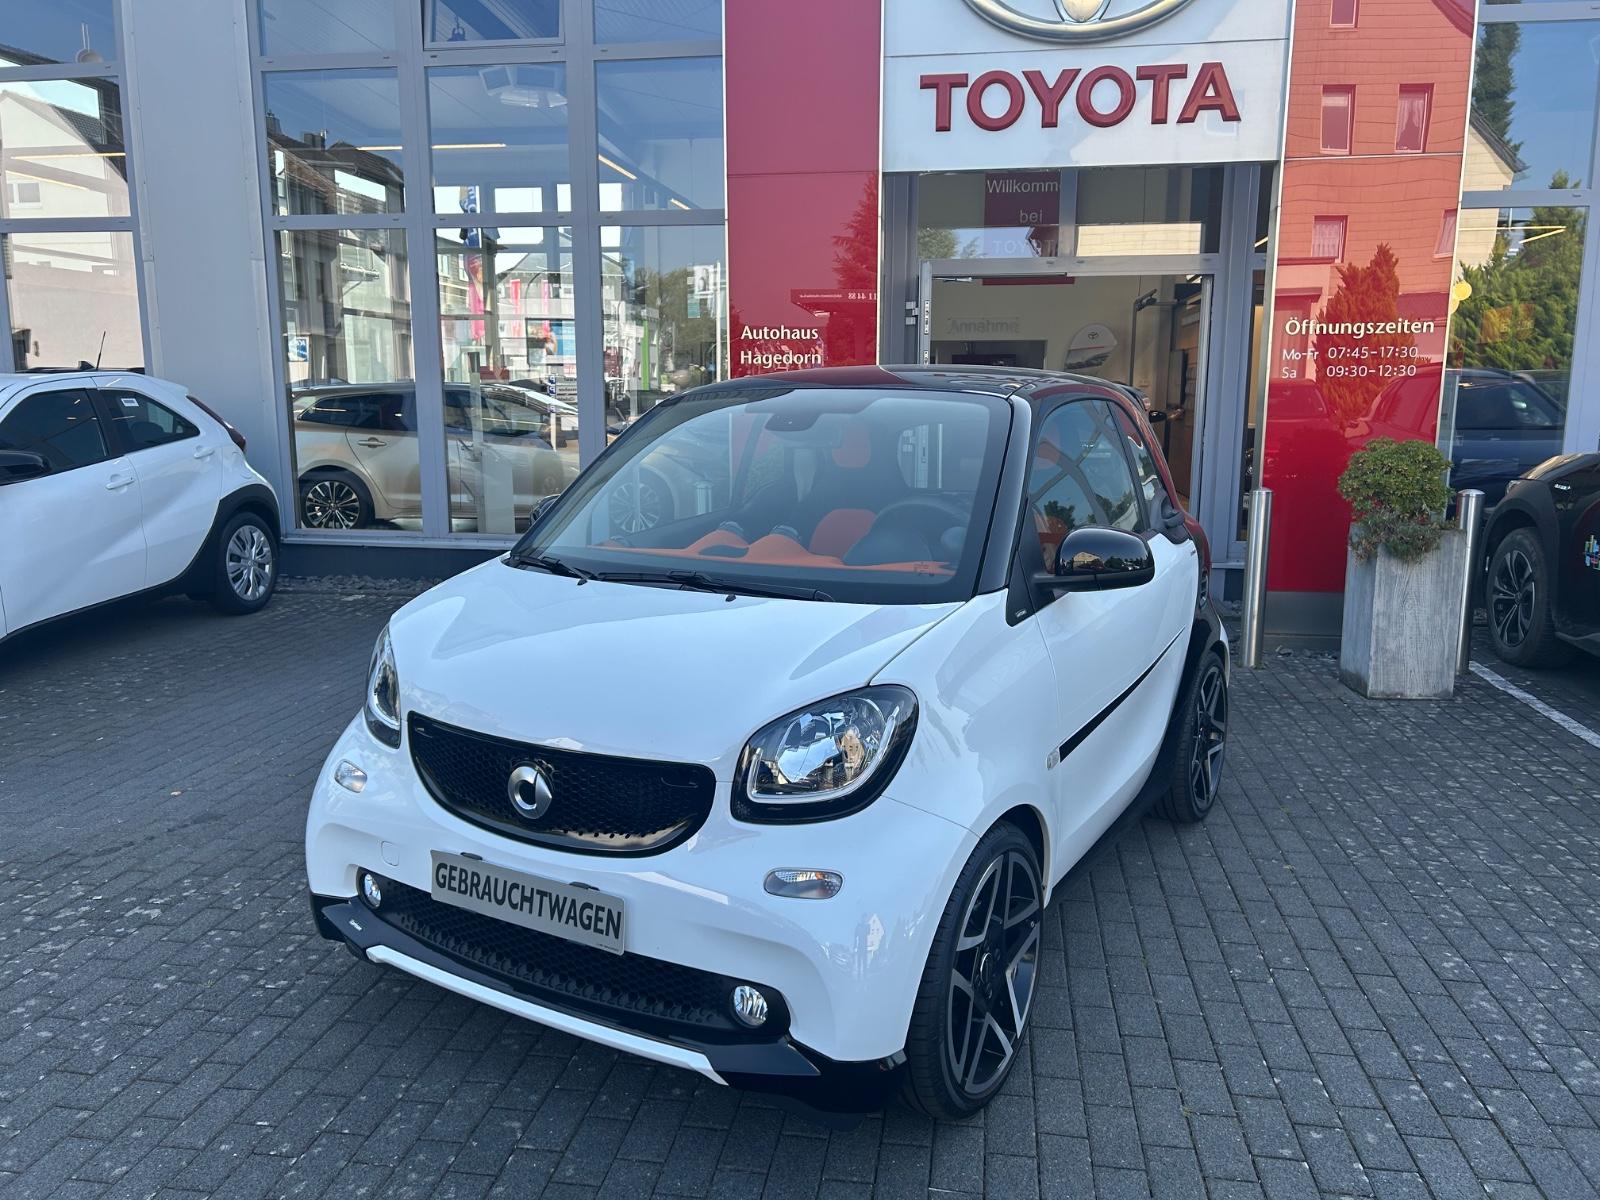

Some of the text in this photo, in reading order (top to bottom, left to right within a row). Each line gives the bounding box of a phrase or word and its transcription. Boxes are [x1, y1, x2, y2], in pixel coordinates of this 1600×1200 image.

[919, 61, 1242, 132] TOYOTA
[986, 179, 1060, 193] Willkomm
[1019, 208, 1043, 223] bei
[740, 325, 819, 340] Autohaus
[1284, 317, 1435, 339] Öffnungszeiten
[740, 350, 822, 369] Hagedorn
[1282, 346, 1419, 361] Mo-Fr 07:45-17:30
[1281, 365, 1417, 379] Sa 09:30-12:30
[434, 861, 622, 940] GEBRAUCHTWAGEN
